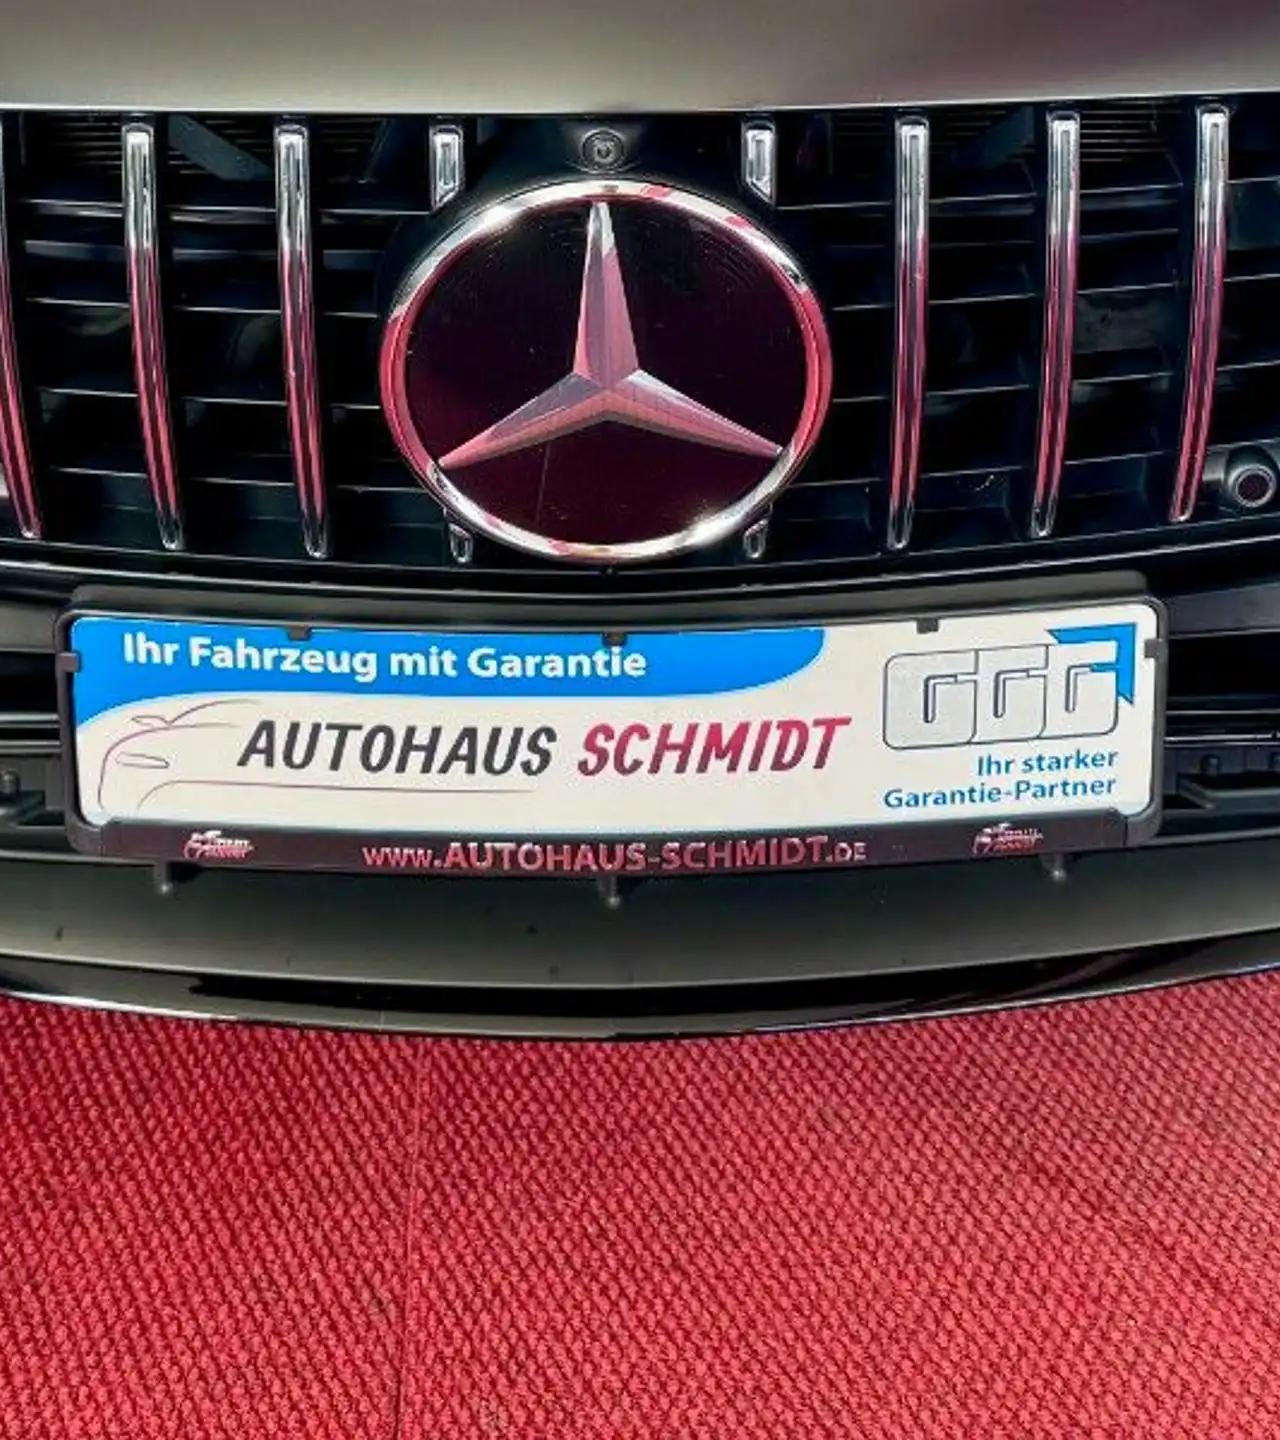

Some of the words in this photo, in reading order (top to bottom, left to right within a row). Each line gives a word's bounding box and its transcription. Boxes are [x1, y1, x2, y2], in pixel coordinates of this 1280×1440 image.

[123, 631, 179, 665] Ihr
[189, 636, 378, 683] Fahrzeug
[390, 645, 458, 677] mit
[467, 645, 647, 679] Garantie
[236, 719, 558, 777] AUTOHAUS
[577, 716, 852, 777] SCHMIDT
[978, 755, 1016, 777] Ihr
[1021, 749, 1119, 774] starker
[883, 777, 1117, 808] Garantie-Partner
[361, 835, 867, 871] www.AUTOHAUS-SCHMIDT.DE
